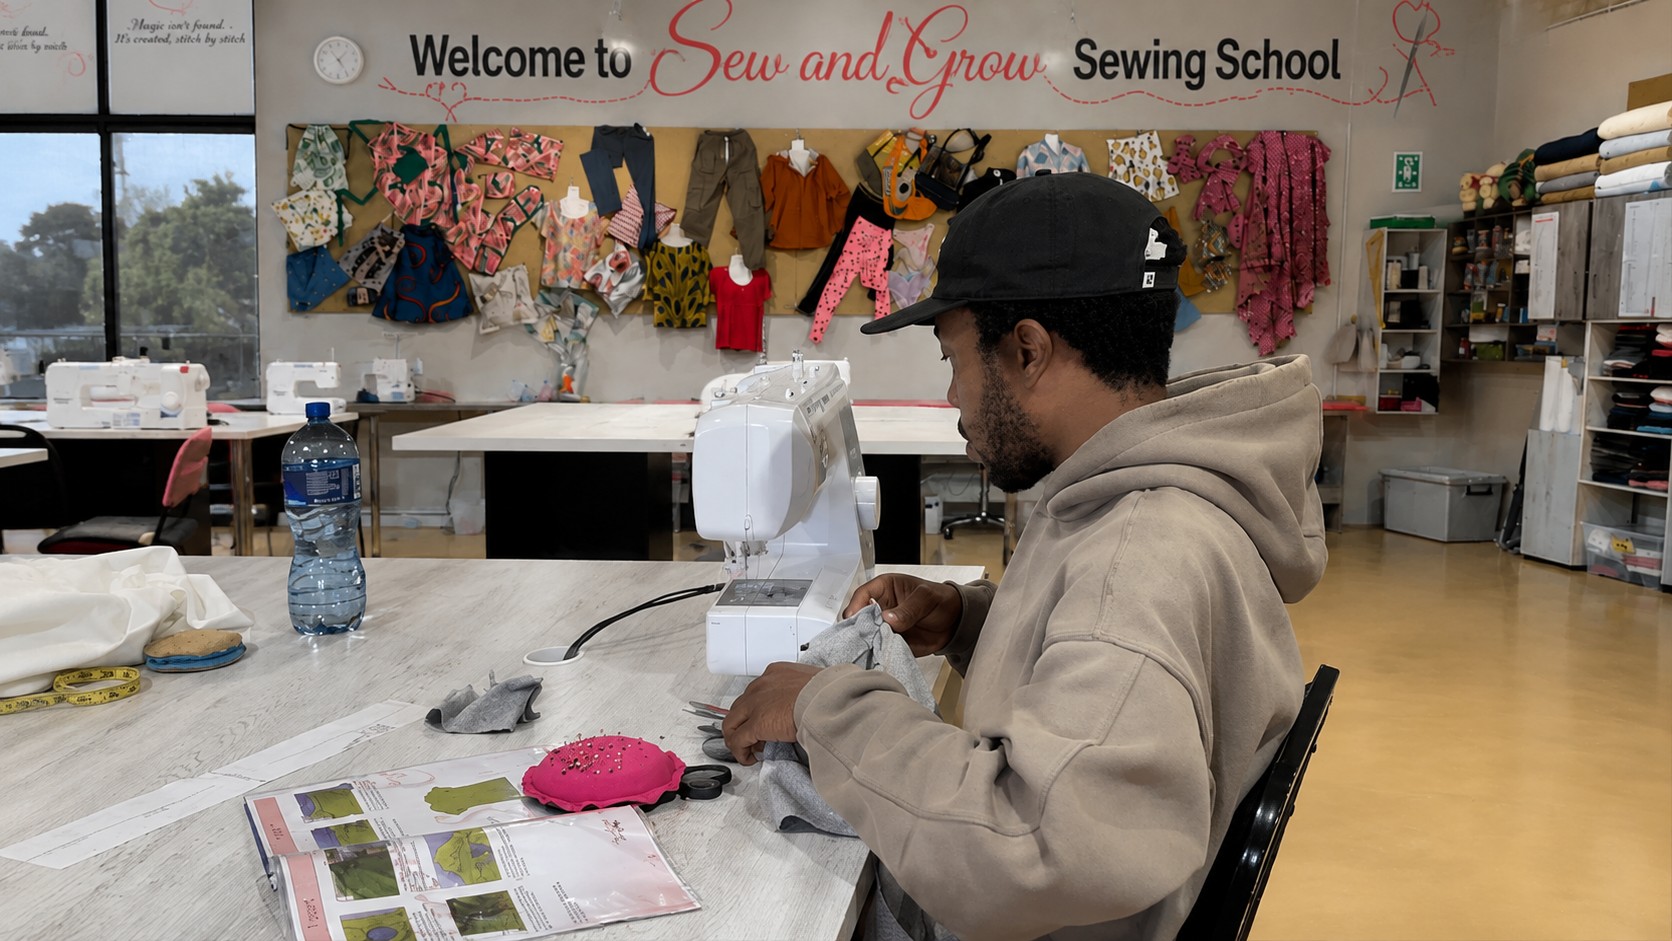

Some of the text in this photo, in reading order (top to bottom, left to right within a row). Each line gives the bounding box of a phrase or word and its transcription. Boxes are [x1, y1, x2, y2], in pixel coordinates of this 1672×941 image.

[127, 18, 165, 33] Magic
[191, 18, 225, 33] found.
[114, 32, 246, 47] It's created, stitch by stitch
[408, 34, 586, 77] Welcome
[594, 38, 632, 78] to
[649, 0, 789, 97] Sew
[799, 11, 889, 81] and
[895, 4, 1047, 120] Grow
[1073, 37, 1206, 91] Sewing
[1215, 37, 1341, 80] School
